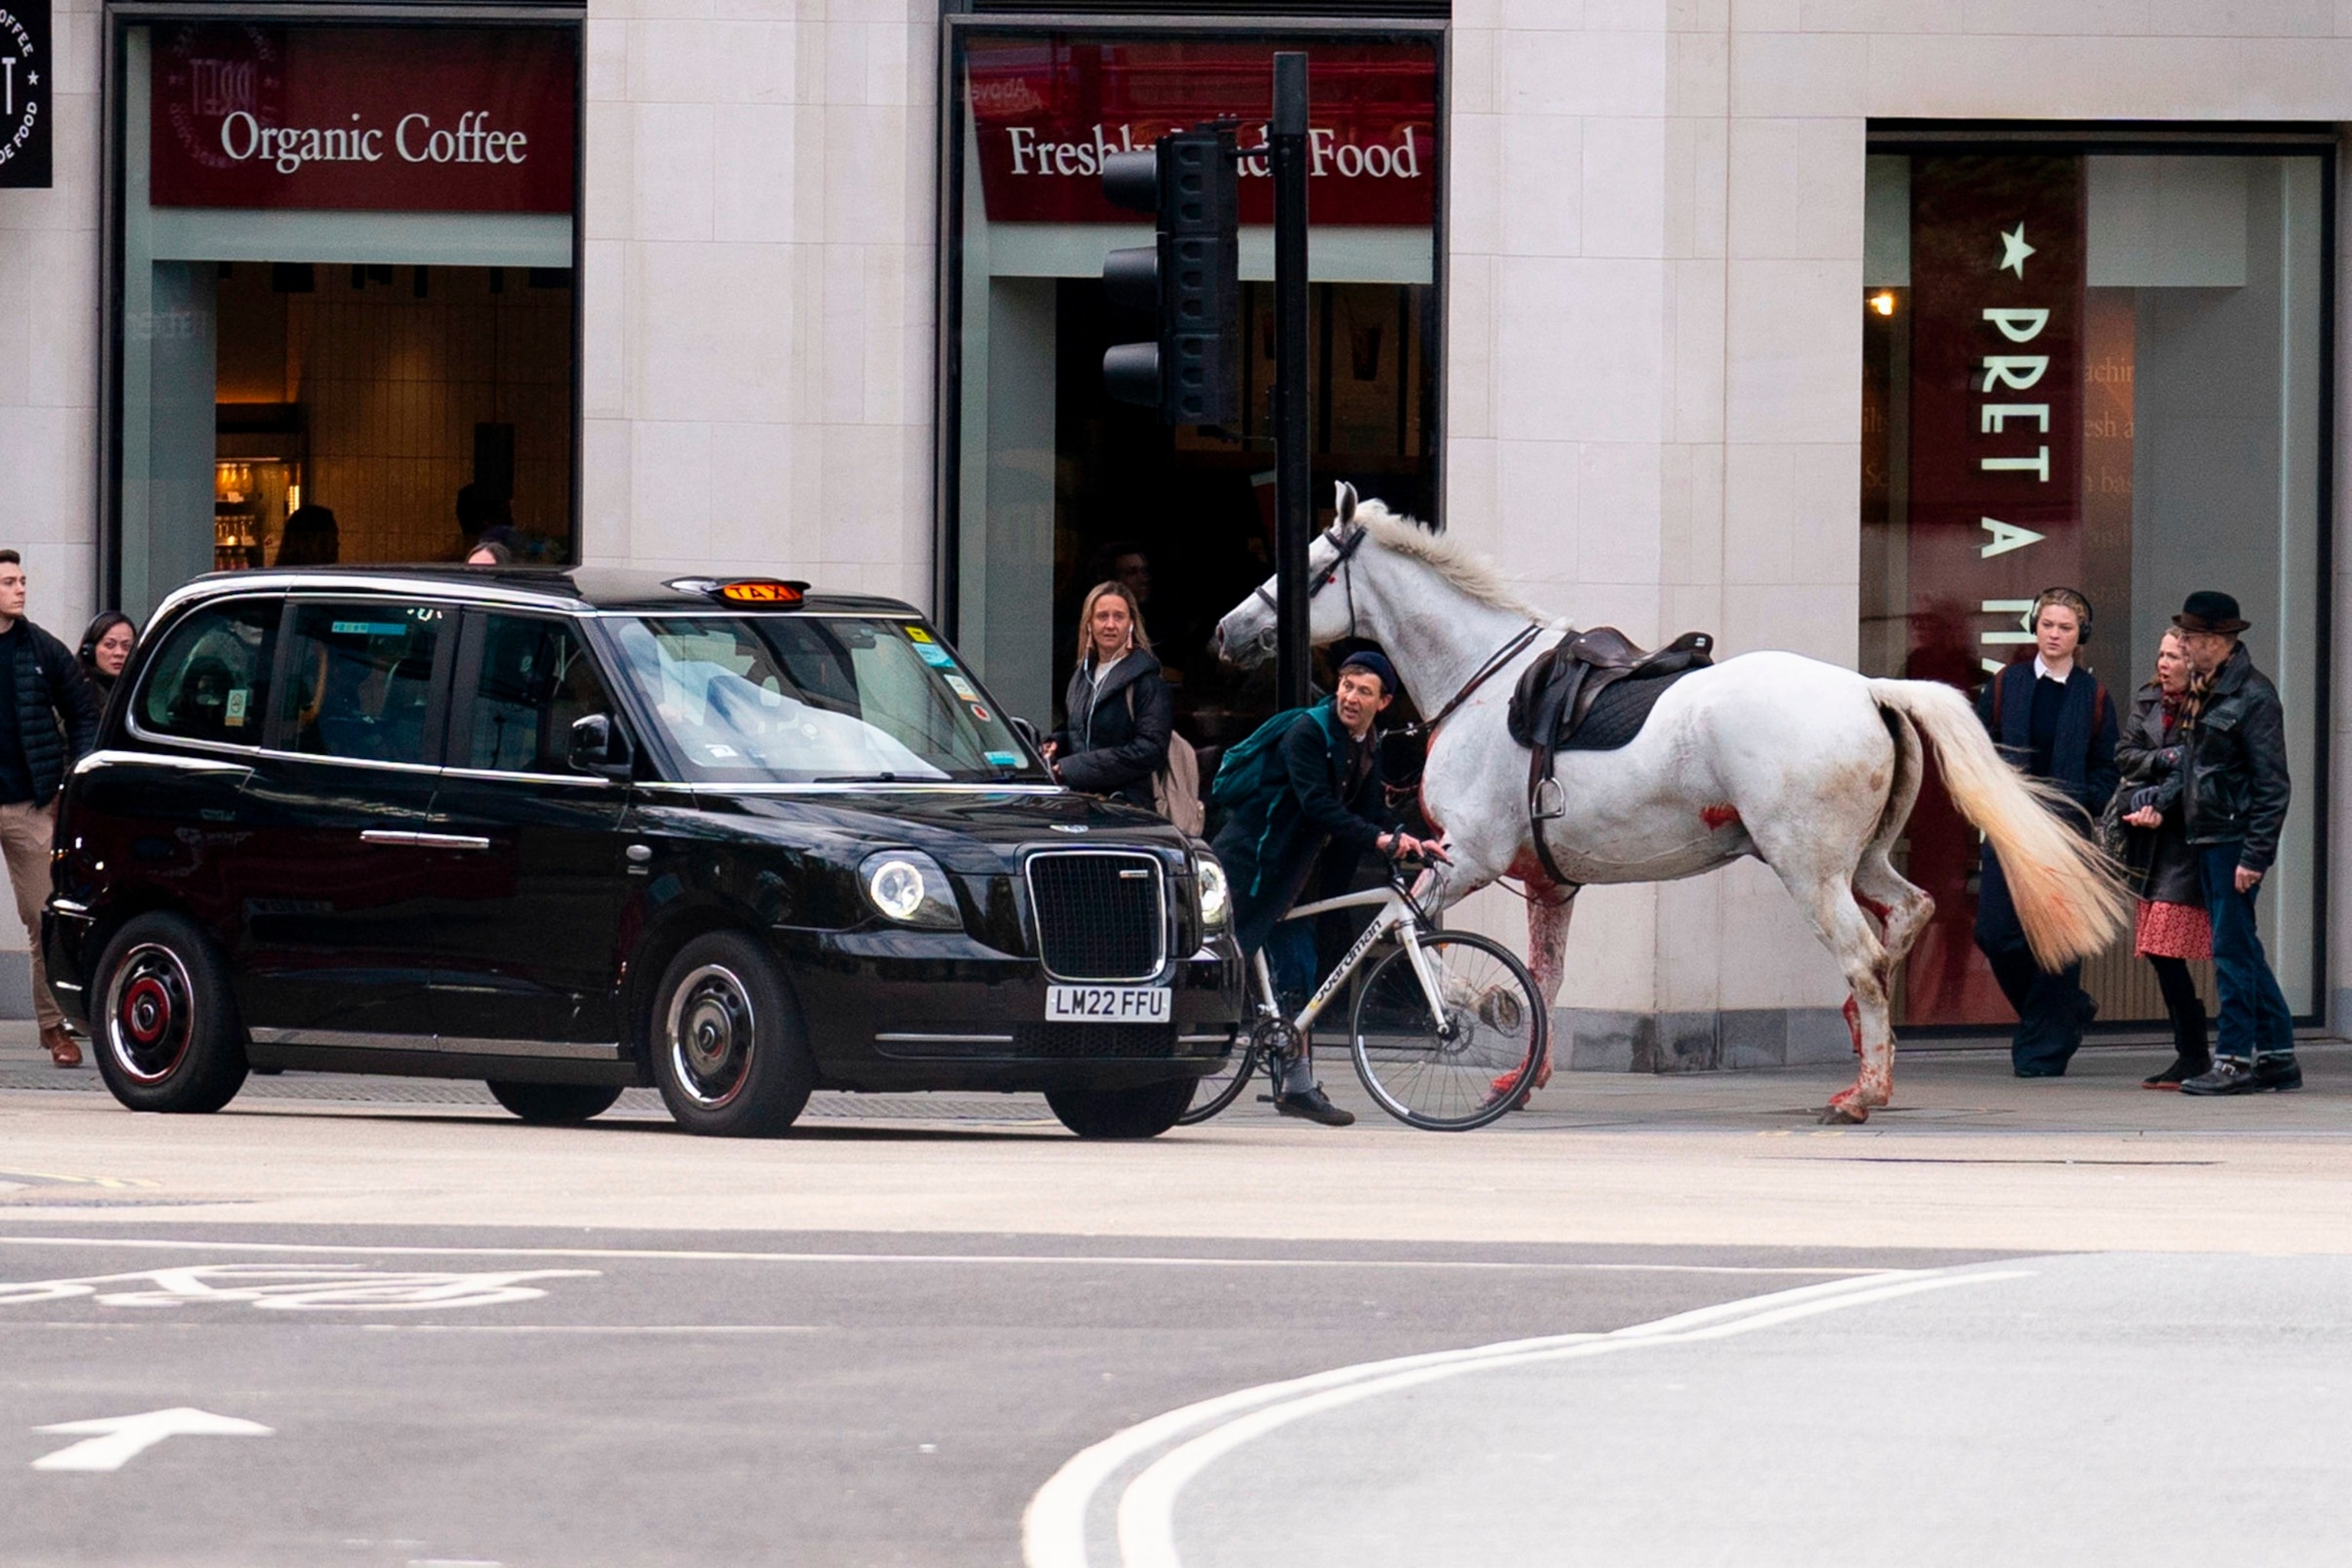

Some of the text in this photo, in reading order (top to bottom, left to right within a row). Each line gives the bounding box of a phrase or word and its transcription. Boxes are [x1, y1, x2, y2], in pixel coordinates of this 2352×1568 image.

[13, 101, 38, 148] FOOD
[221, 111, 383, 174] Organic
[395, 111, 528, 163] Coffee
[1005, 123, 1157, 176] Freshl
[1308, 126, 1422, 178] Food
[1981, 309, 2050, 693] PRET A M
[730, 586, 797, 599] TAXI
[1057, 989, 1162, 1016] LM22 FFU
